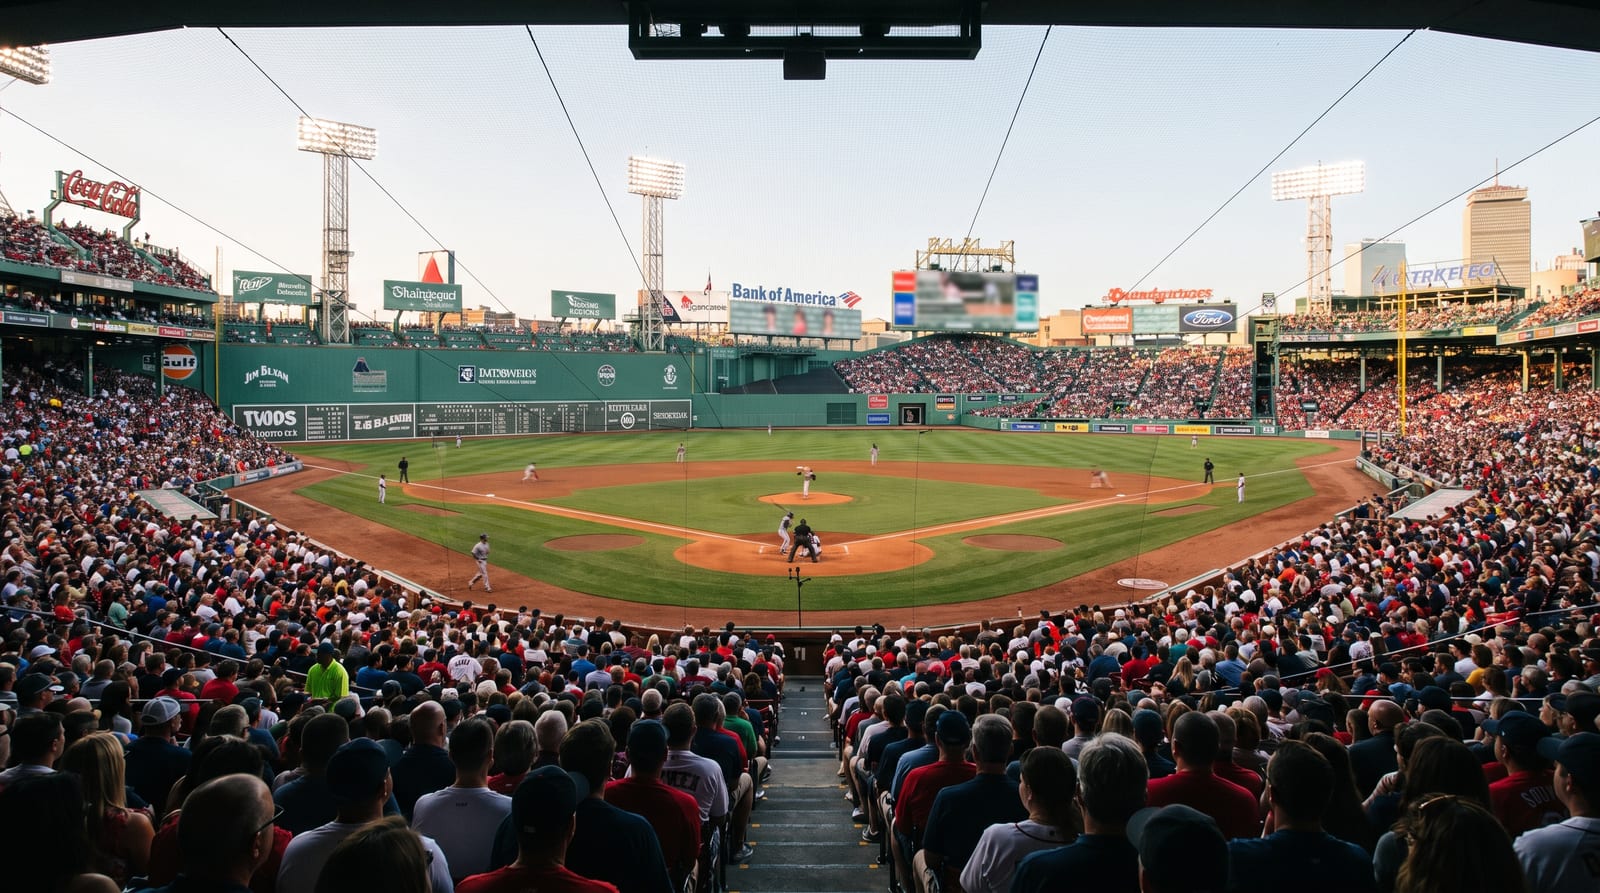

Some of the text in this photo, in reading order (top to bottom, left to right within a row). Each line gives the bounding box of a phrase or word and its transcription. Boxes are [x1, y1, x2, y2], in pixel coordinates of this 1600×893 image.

[732, 283, 836, 306] Bank of America
[1193, 311, 1223, 325] Ford
[163, 356, 195, 367] Gulf
